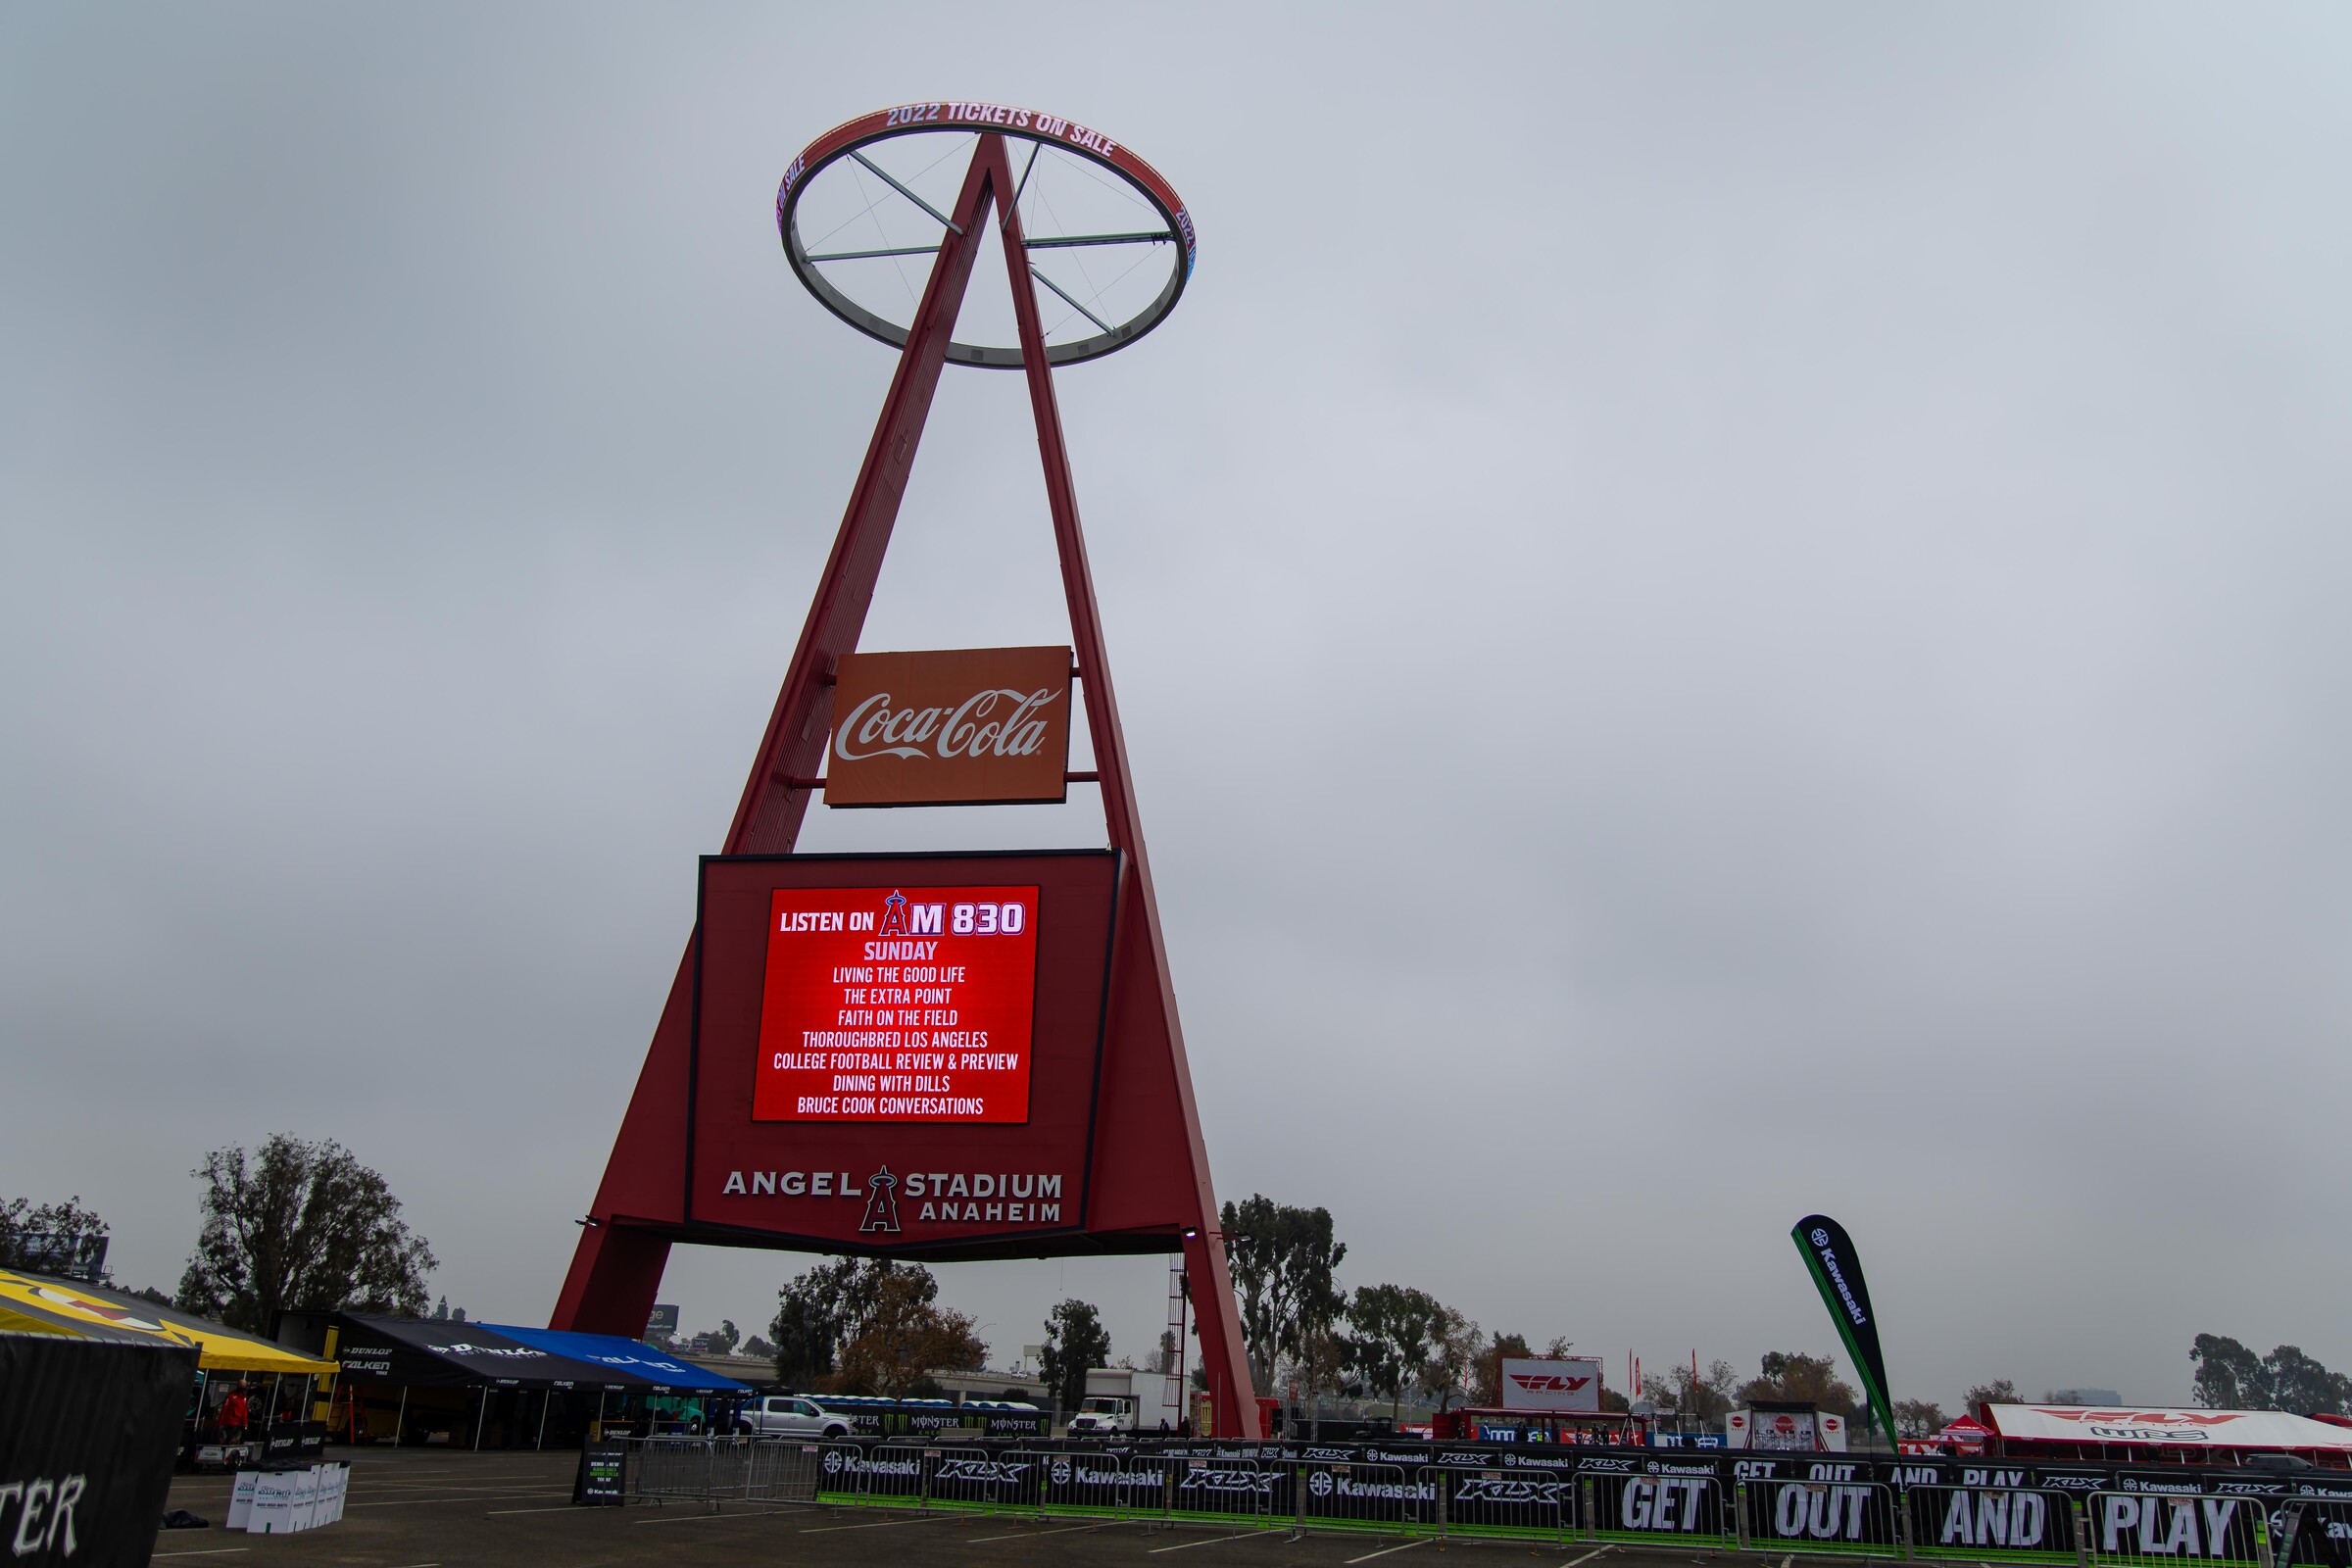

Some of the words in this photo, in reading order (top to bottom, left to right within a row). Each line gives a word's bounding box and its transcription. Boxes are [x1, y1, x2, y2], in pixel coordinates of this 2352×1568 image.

[886, 102, 941, 126] 2022
[947, 102, 1032, 127] TICKETS
[1035, 114, 1068, 137] ON
[1069, 123, 1114, 158] SALE
[784, 152, 806, 191] SALE
[1175, 206, 1195, 245] 2022
[835, 686, 1064, 760] Coca-Cola
[780, 912, 845, 932] LISTEN
[849, 911, 875, 931] ON
[951, 902, 1026, 936] 830
[863, 941, 939, 961] SUNDAY
[833, 966, 873, 984] LIVING
[876, 966, 900, 983] THE
[903, 966, 937, 983] GOOD
[940, 966, 966, 983] LIFE
[844, 988, 867, 1004] THE
[869, 988, 911, 1004] EXTRA
[914, 988, 953, 1004] POINT
[837, 1009, 874, 1026] FAITH
[876, 1009, 894, 1026] ON
[896, 1009, 920, 1026] THE
[922, 1009, 958, 1026] FIELD
[803, 1031, 902, 1048] THOROUGHBRED
[904, 1031, 929, 1049] LOS
[931, 1031, 989, 1049] ANGELES
[773, 1053, 827, 1070] COLLEGE
[830, 1053, 893, 1070] FOOTBALL
[896, 1054, 945, 1070] REVIEW
[948, 1054, 957, 1070] &
[960, 1054, 1019, 1070] PREVIEW
[833, 1074, 876, 1092] DINING
[879, 1075, 911, 1092] WITH
[914, 1075, 951, 1092] DILLS
[797, 1097, 839, 1114] BRUCE
[842, 1097, 876, 1114] COOK
[879, 1097, 984, 1115] CONVERSATIONS
[722, 1170, 862, 1197] ANGEL
[904, 1172, 1062, 1199] STADIUM
[918, 1200, 1060, 1222] ANAHEIM
[1820, 1248, 1867, 1325] Kawasaki
[350, 1347, 393, 1355] DUNLOP
[342, 1359, 391, 1370] FALKEN
[1509, 1374, 1592, 1391] FLY
[911, 1415, 959, 1429] MONSTER
[991, 1418, 1037, 1431] MONSTER
[2029, 1408, 2246, 1425] FLY
[1301, 1447, 1357, 1461] KLX
[1379, 1451, 1429, 1464] Kawasaki
[1437, 1452, 1493, 1465] KLX
[1517, 1456, 1569, 1468] Kawasaki
[844, 1456, 920, 1476] Kawasaki
[1577, 1457, 1638, 1471] KLX
[1661, 1463, 1715, 1475] Kawasaki
[1074, 1465, 1163, 1487] Kawasaki
[1733, 1460, 1777, 1483] GET
[1809, 1463, 1855, 1481] OUT
[1890, 1467, 1938, 1485] AND
[1962, 1470, 2024, 1487] PLAY
[1336, 1477, 1436, 1500] Kawasaki
[2041, 1477, 2108, 1490] KLX
[2139, 1481, 2202, 1494] Kawasaki
[2217, 1483, 2285, 1494] KLX
[1621, 1478, 1708, 1533] GET
[1775, 1483, 1872, 1540] OUT
[1939, 1490, 2045, 1546] AND
[2102, 1495, 2237, 1556] PLAY
